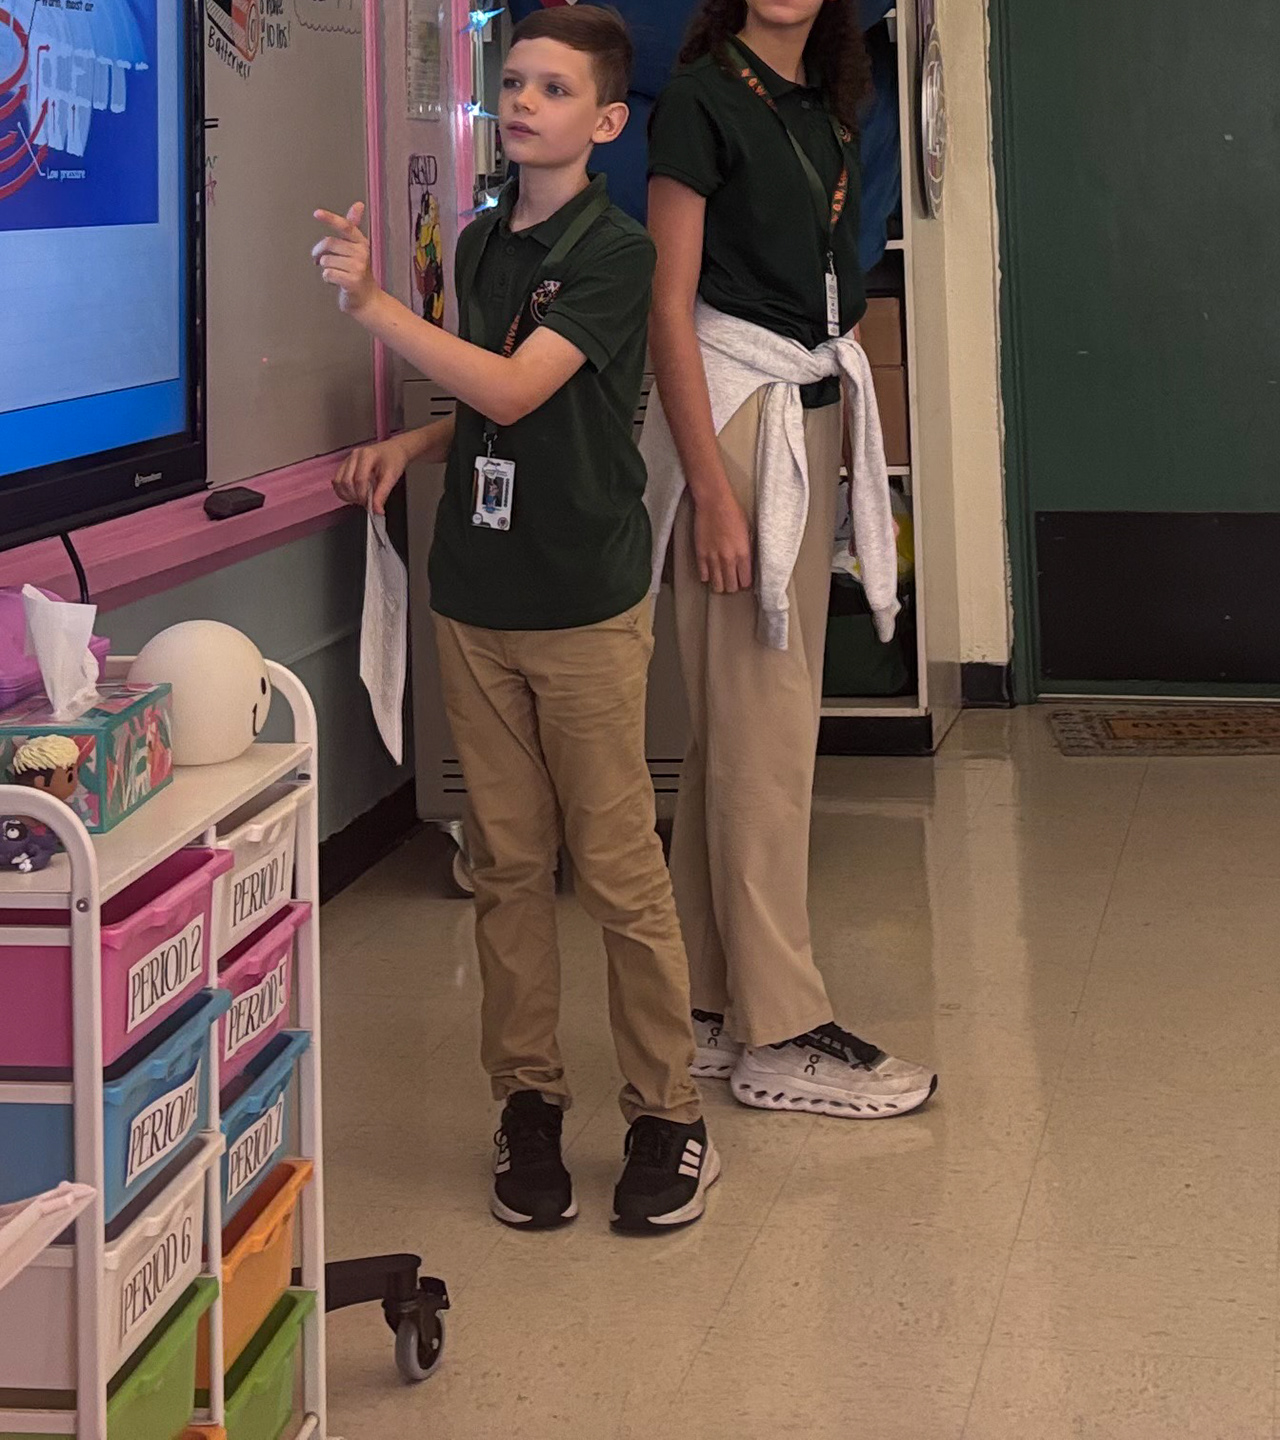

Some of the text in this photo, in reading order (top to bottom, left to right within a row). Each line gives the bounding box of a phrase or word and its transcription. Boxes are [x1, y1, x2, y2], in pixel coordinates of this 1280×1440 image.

[232, 864, 276, 928] PERIOD
[130, 924, 202, 1024] PERIOD 2
[227, 973, 278, 1052] PERIOD
[129, 1086, 193, 1177] PERIOD
[230, 1113, 272, 1198] PERIOD
[123, 1216, 192, 1336] PERIOD 6
